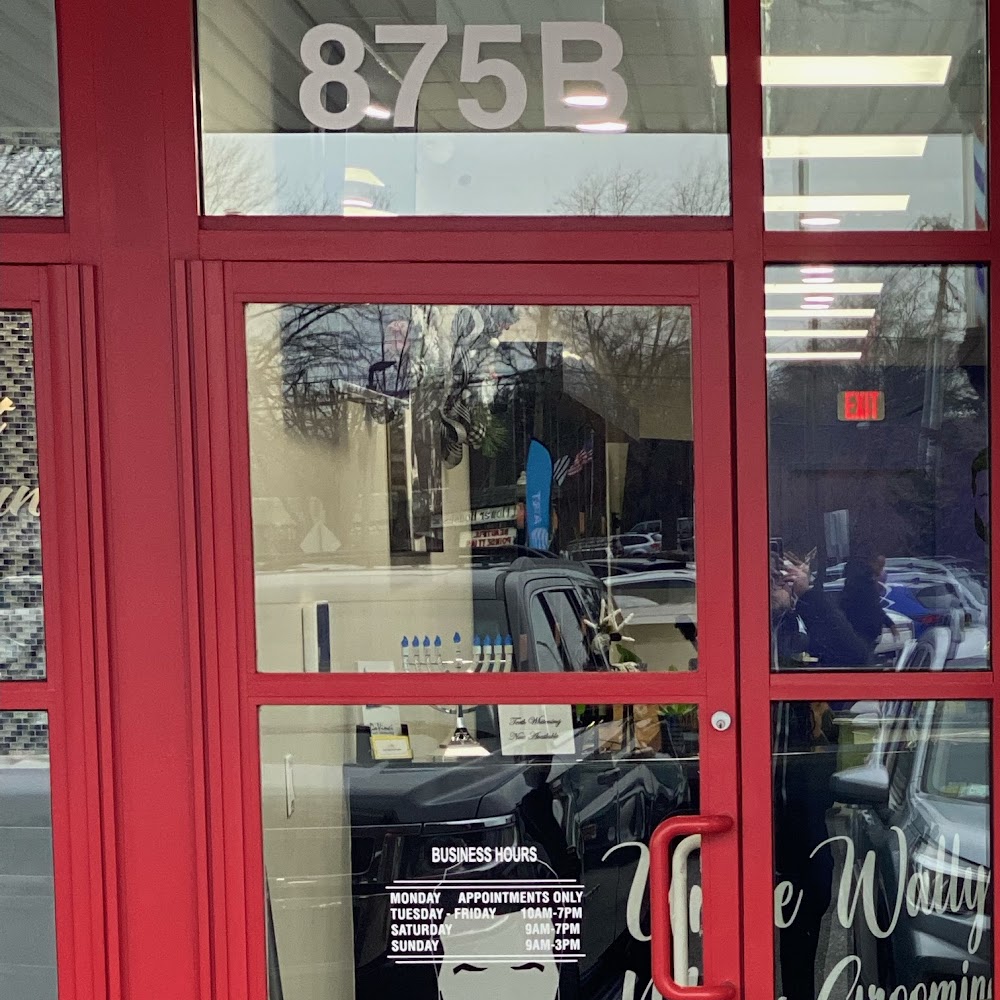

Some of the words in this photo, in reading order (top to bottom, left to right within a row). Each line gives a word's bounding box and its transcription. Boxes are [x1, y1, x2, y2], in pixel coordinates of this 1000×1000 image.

[299, 21, 628, 130] 875B
[844, 390, 880, 420] EXIT
[431, 846, 492, 863] BUSINESS
[494, 846, 538, 863] HOURS
[389, 891, 441, 905] MONDAY
[458, 891, 550, 904] APPOINTMENTS
[552, 890, 584, 903] ONLY
[809, 826, 990, 954] Wally
[390, 908, 444, 920] TUESDAY
[454, 907, 497, 920] FRIDAY
[520, 906, 583, 919] 10AM-7PM
[390, 923, 453, 937] SATURDAY
[525, 922, 581, 935] 9AM-7PM
[391, 939, 440, 952] SUNDAY
[525, 939, 581, 951] 9AM-3PM
